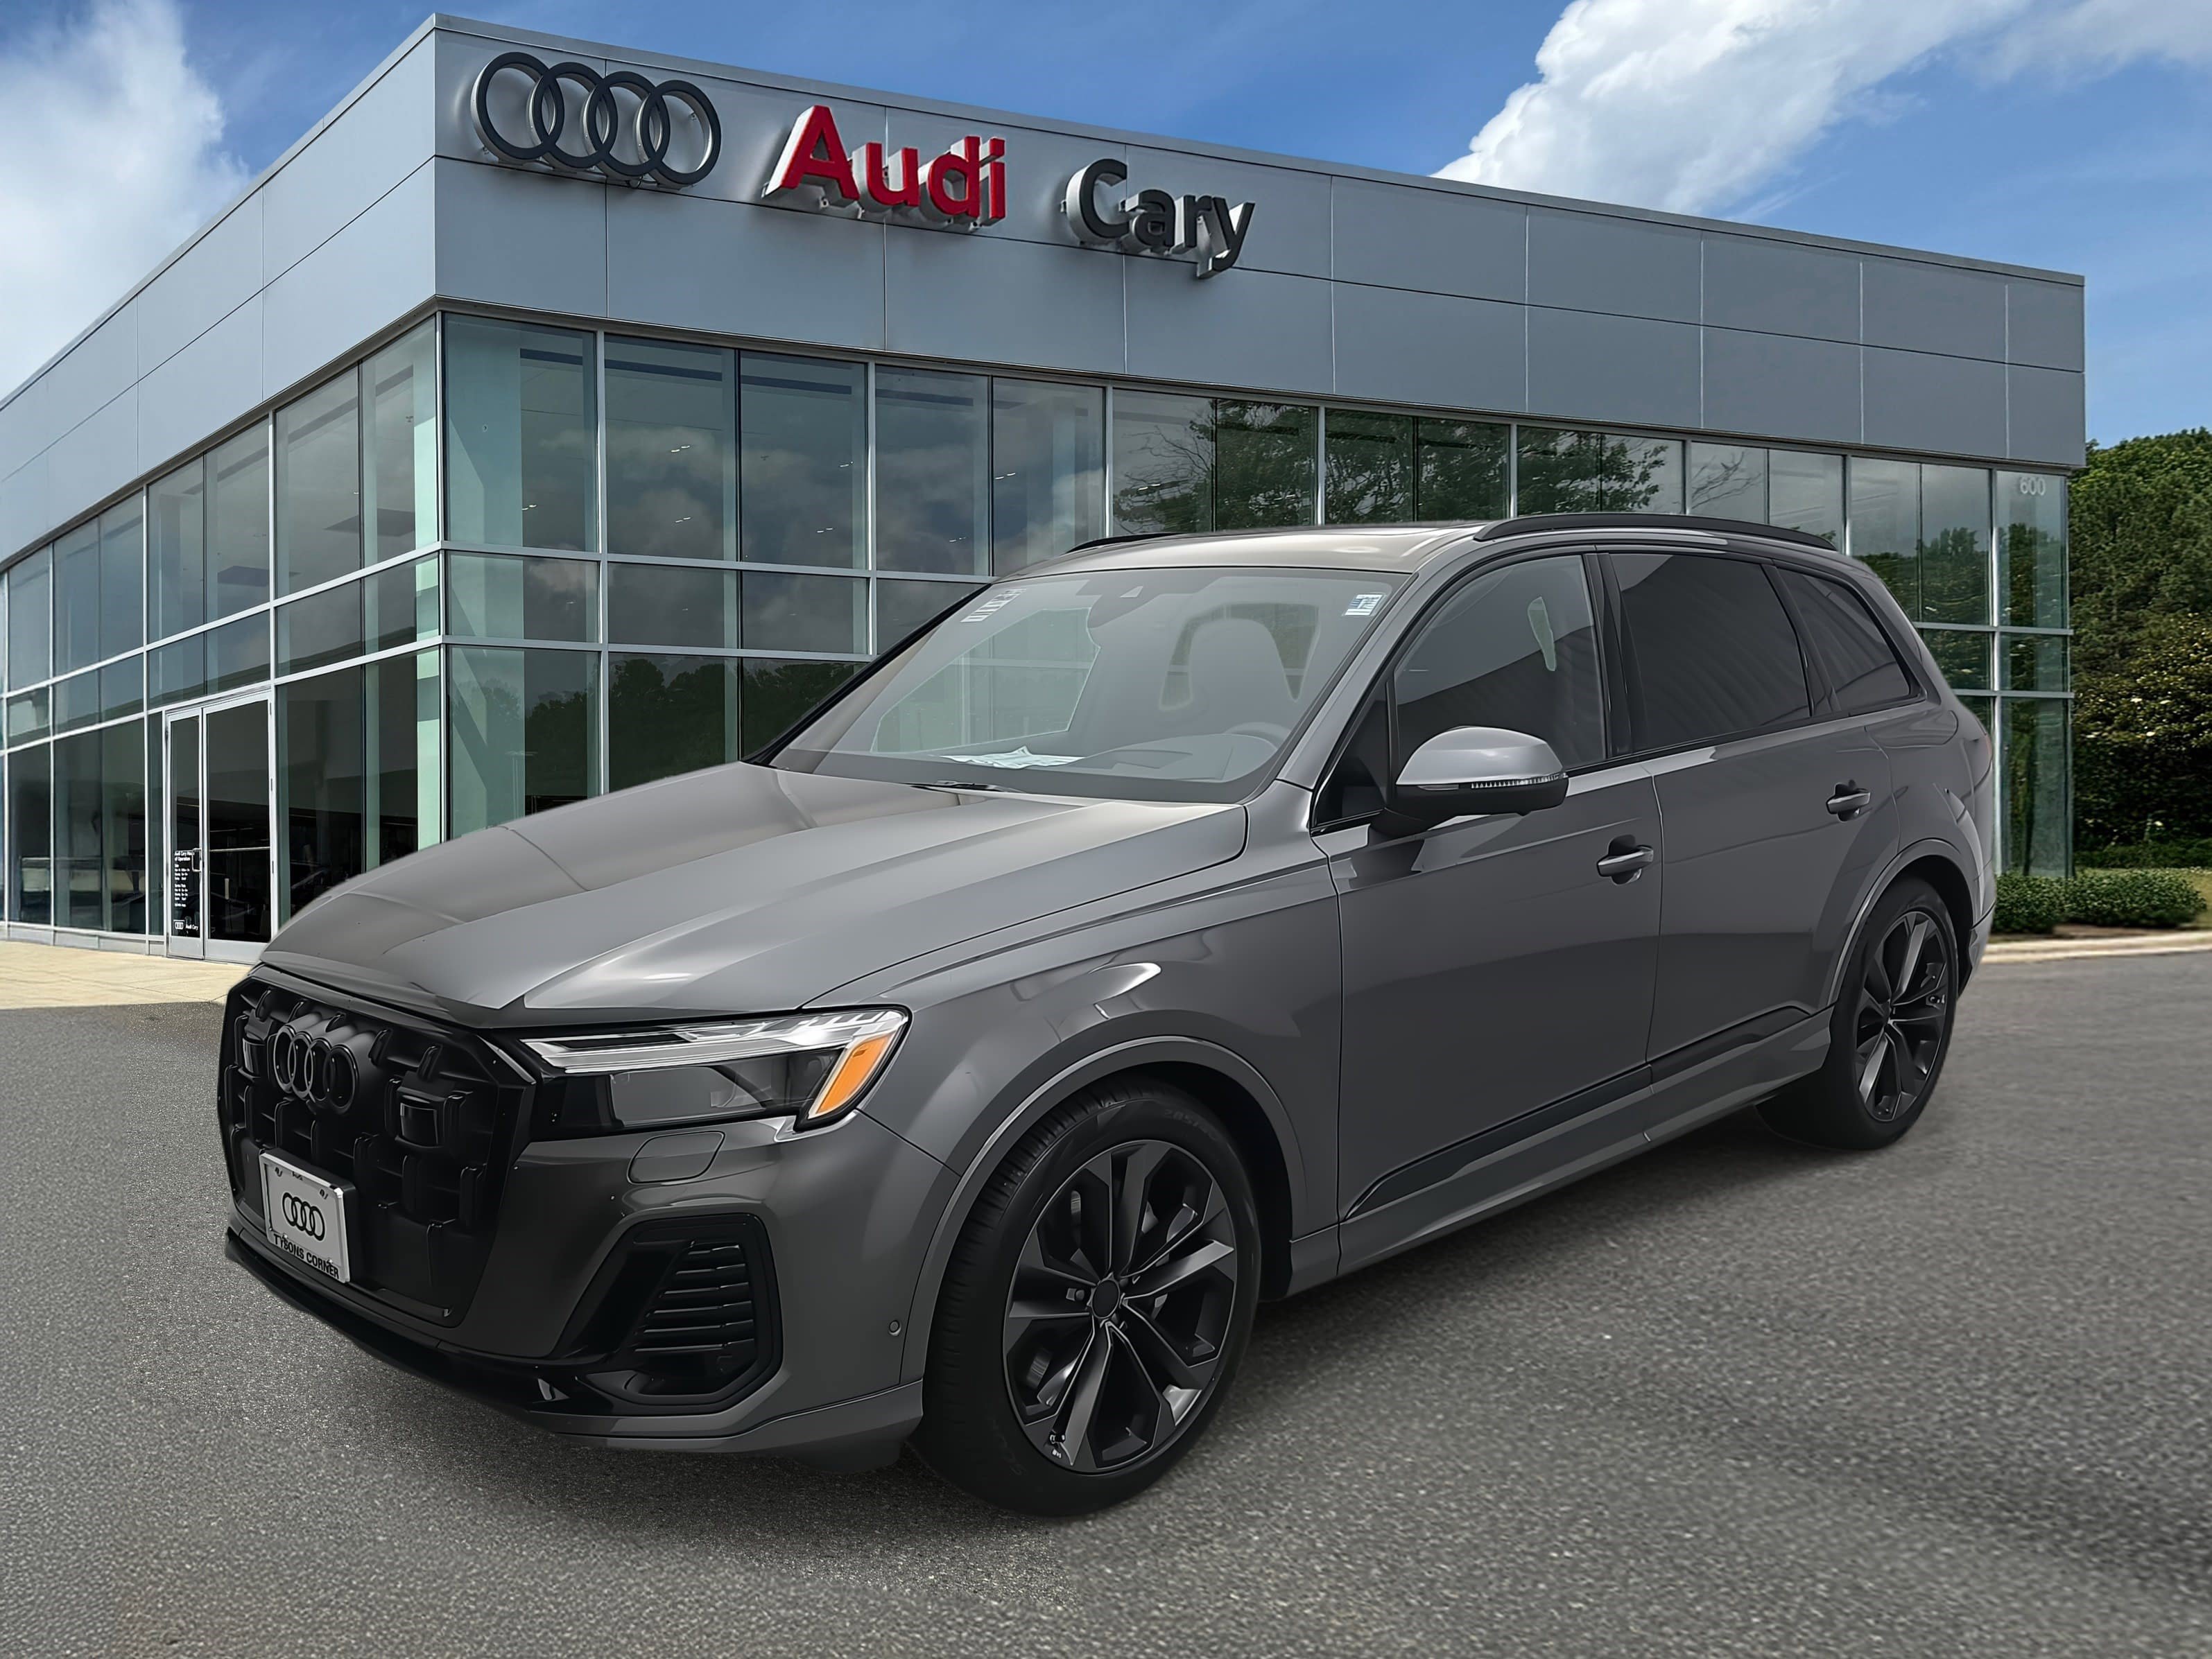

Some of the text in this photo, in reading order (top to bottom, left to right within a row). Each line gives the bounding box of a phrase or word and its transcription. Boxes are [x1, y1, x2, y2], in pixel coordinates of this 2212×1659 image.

[771, 105, 1256, 275] Audi Cary
[2020, 476, 2046, 496] 600
[273, 1233, 339, 1280] TYSONS CORNER
